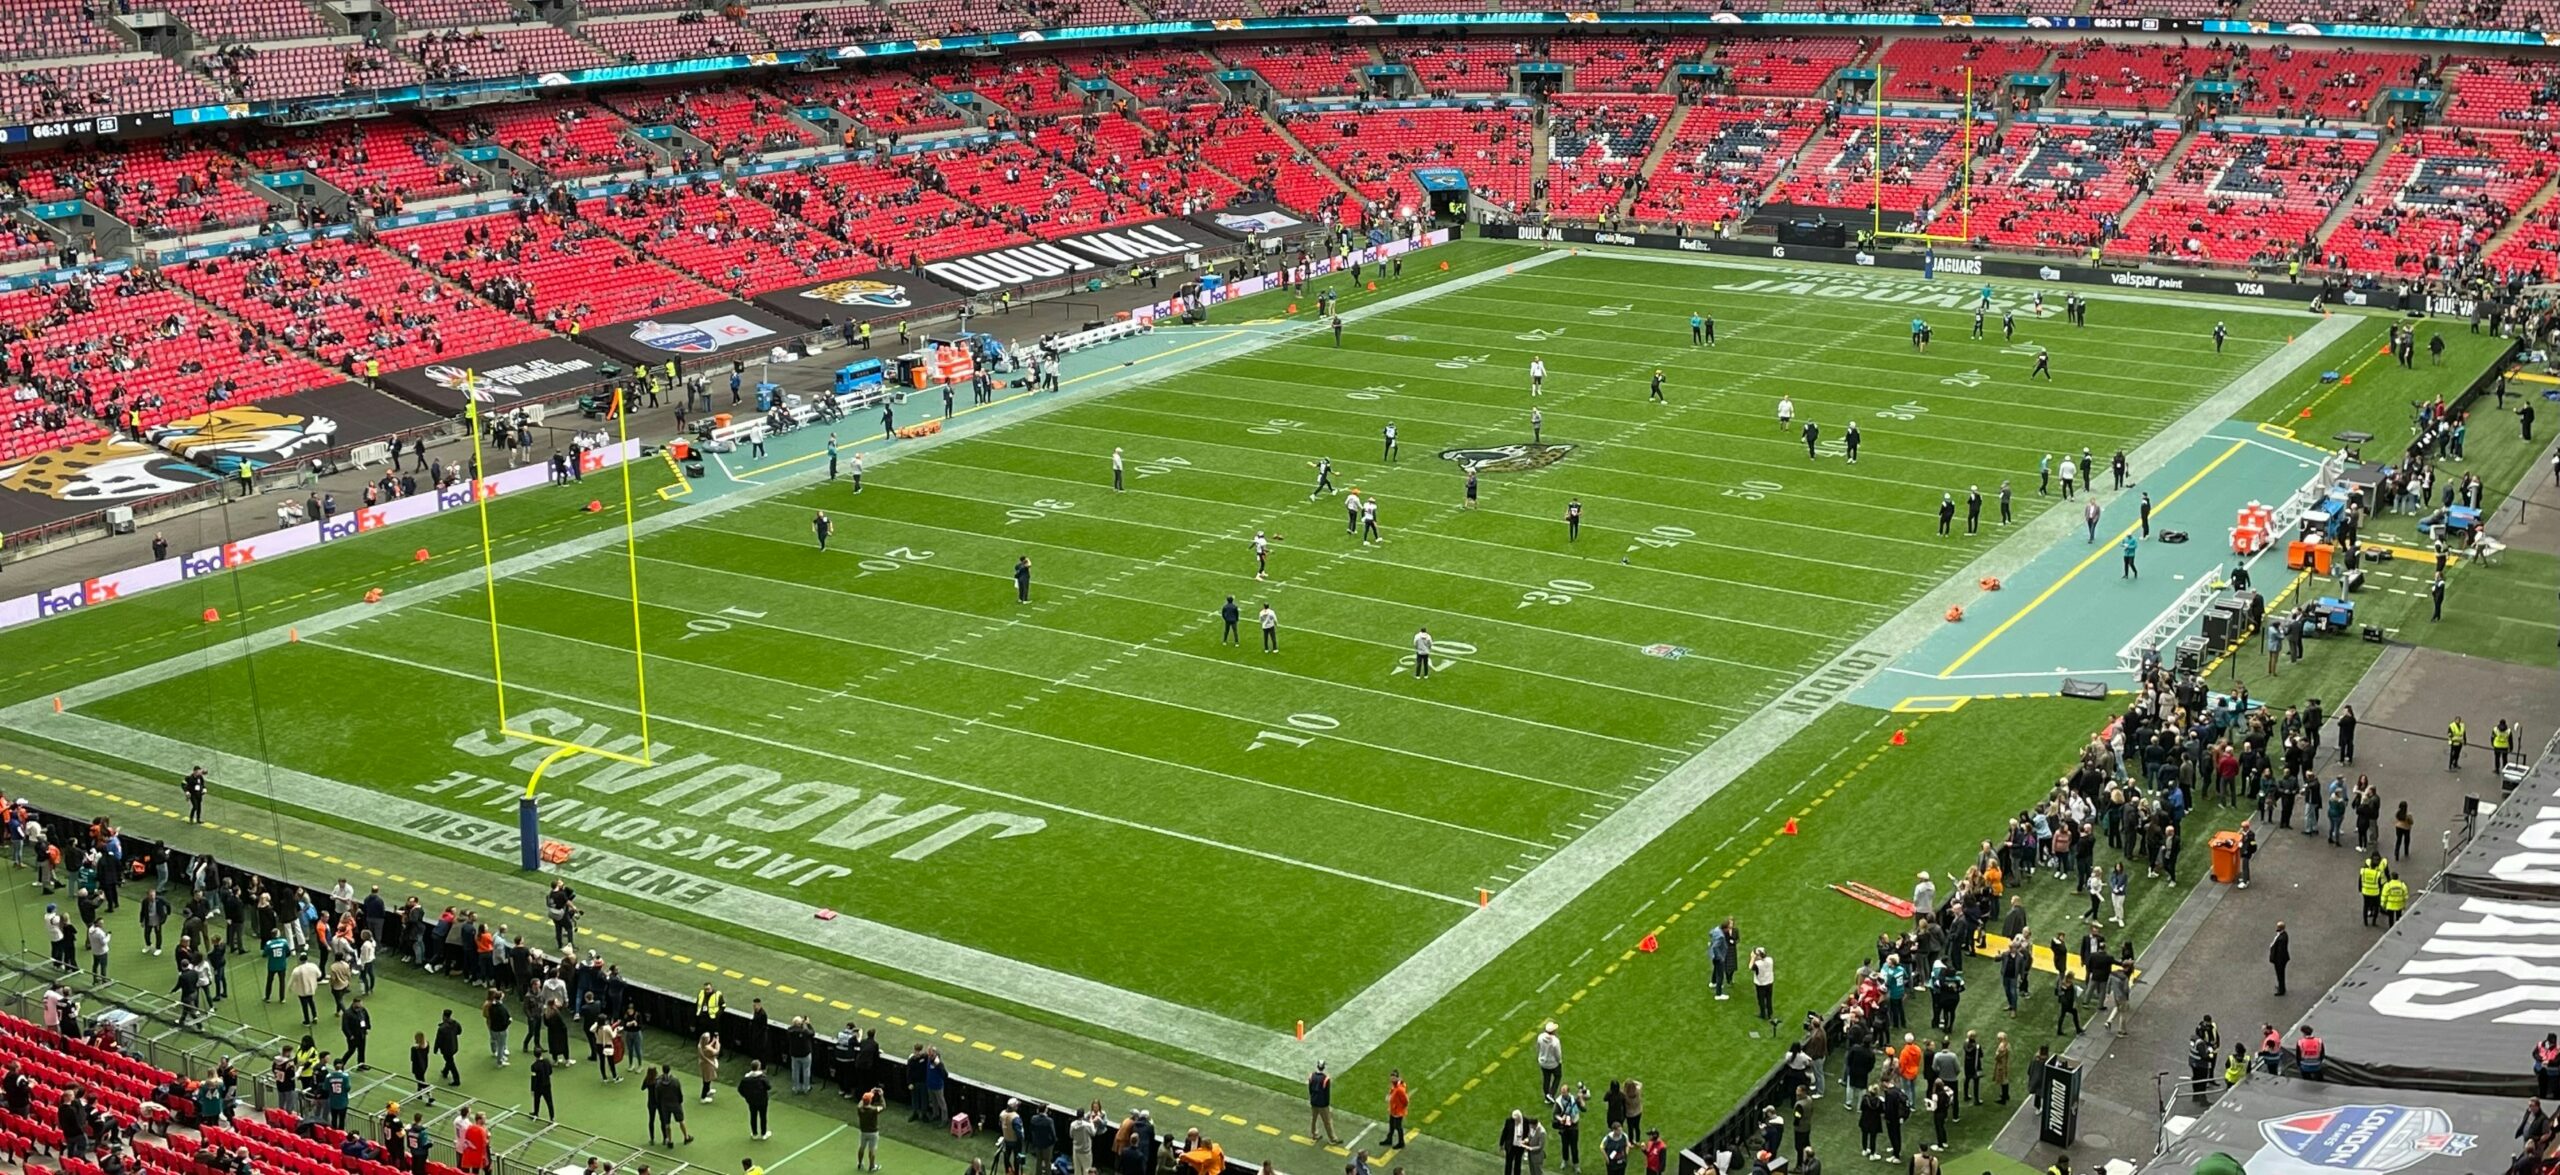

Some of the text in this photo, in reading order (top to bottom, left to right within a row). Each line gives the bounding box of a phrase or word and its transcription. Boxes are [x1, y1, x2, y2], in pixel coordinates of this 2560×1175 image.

[583, 64, 648, 80] BRONCOS
[673, 57, 733, 72] JAGUARS
[33, 122, 69, 138] 66:31
[73, 122, 92, 133] 1ST
[1679, 239, 1709, 252] FedEx
[1773, 246, 1785, 258] IG
[1933, 257, 1982, 275] JAGUARS
[1785, 275, 2035, 300] JACKSONVILE
[2111, 271, 2183, 290] valspar paint
[2235, 282, 2265, 296] VISA
[1712, 280, 2065, 318] JAGUARS
[493, 358, 588, 385] FOUNDATION
[437, 479, 499, 512] FedEx
[1721, 480, 1783, 501] 50
[1004, 499, 1074, 519] 30
[320, 507, 387, 544] FedEx
[1634, 525, 1696, 549] 40
[181, 541, 256, 579] FedEx
[858, 547, 934, 571] 20
[38, 577, 120, 618] FedEx
[1522, 579, 1595, 606] 30
[686, 606, 767, 632] 10
[1783, 649, 1892, 716] LONDON
[1256, 713, 1340, 749] 10
[453, 707, 1047, 862] JAGUARS
[413, 770, 852, 887] JACKSONVILLE
[402, 811, 724, 902] END RCISM
[2049, 1079, 2067, 1136] DUUUVAL!
[2323, 1123, 2352, 1147] GAMES
[2325, 1109, 2394, 1164] LONDON
